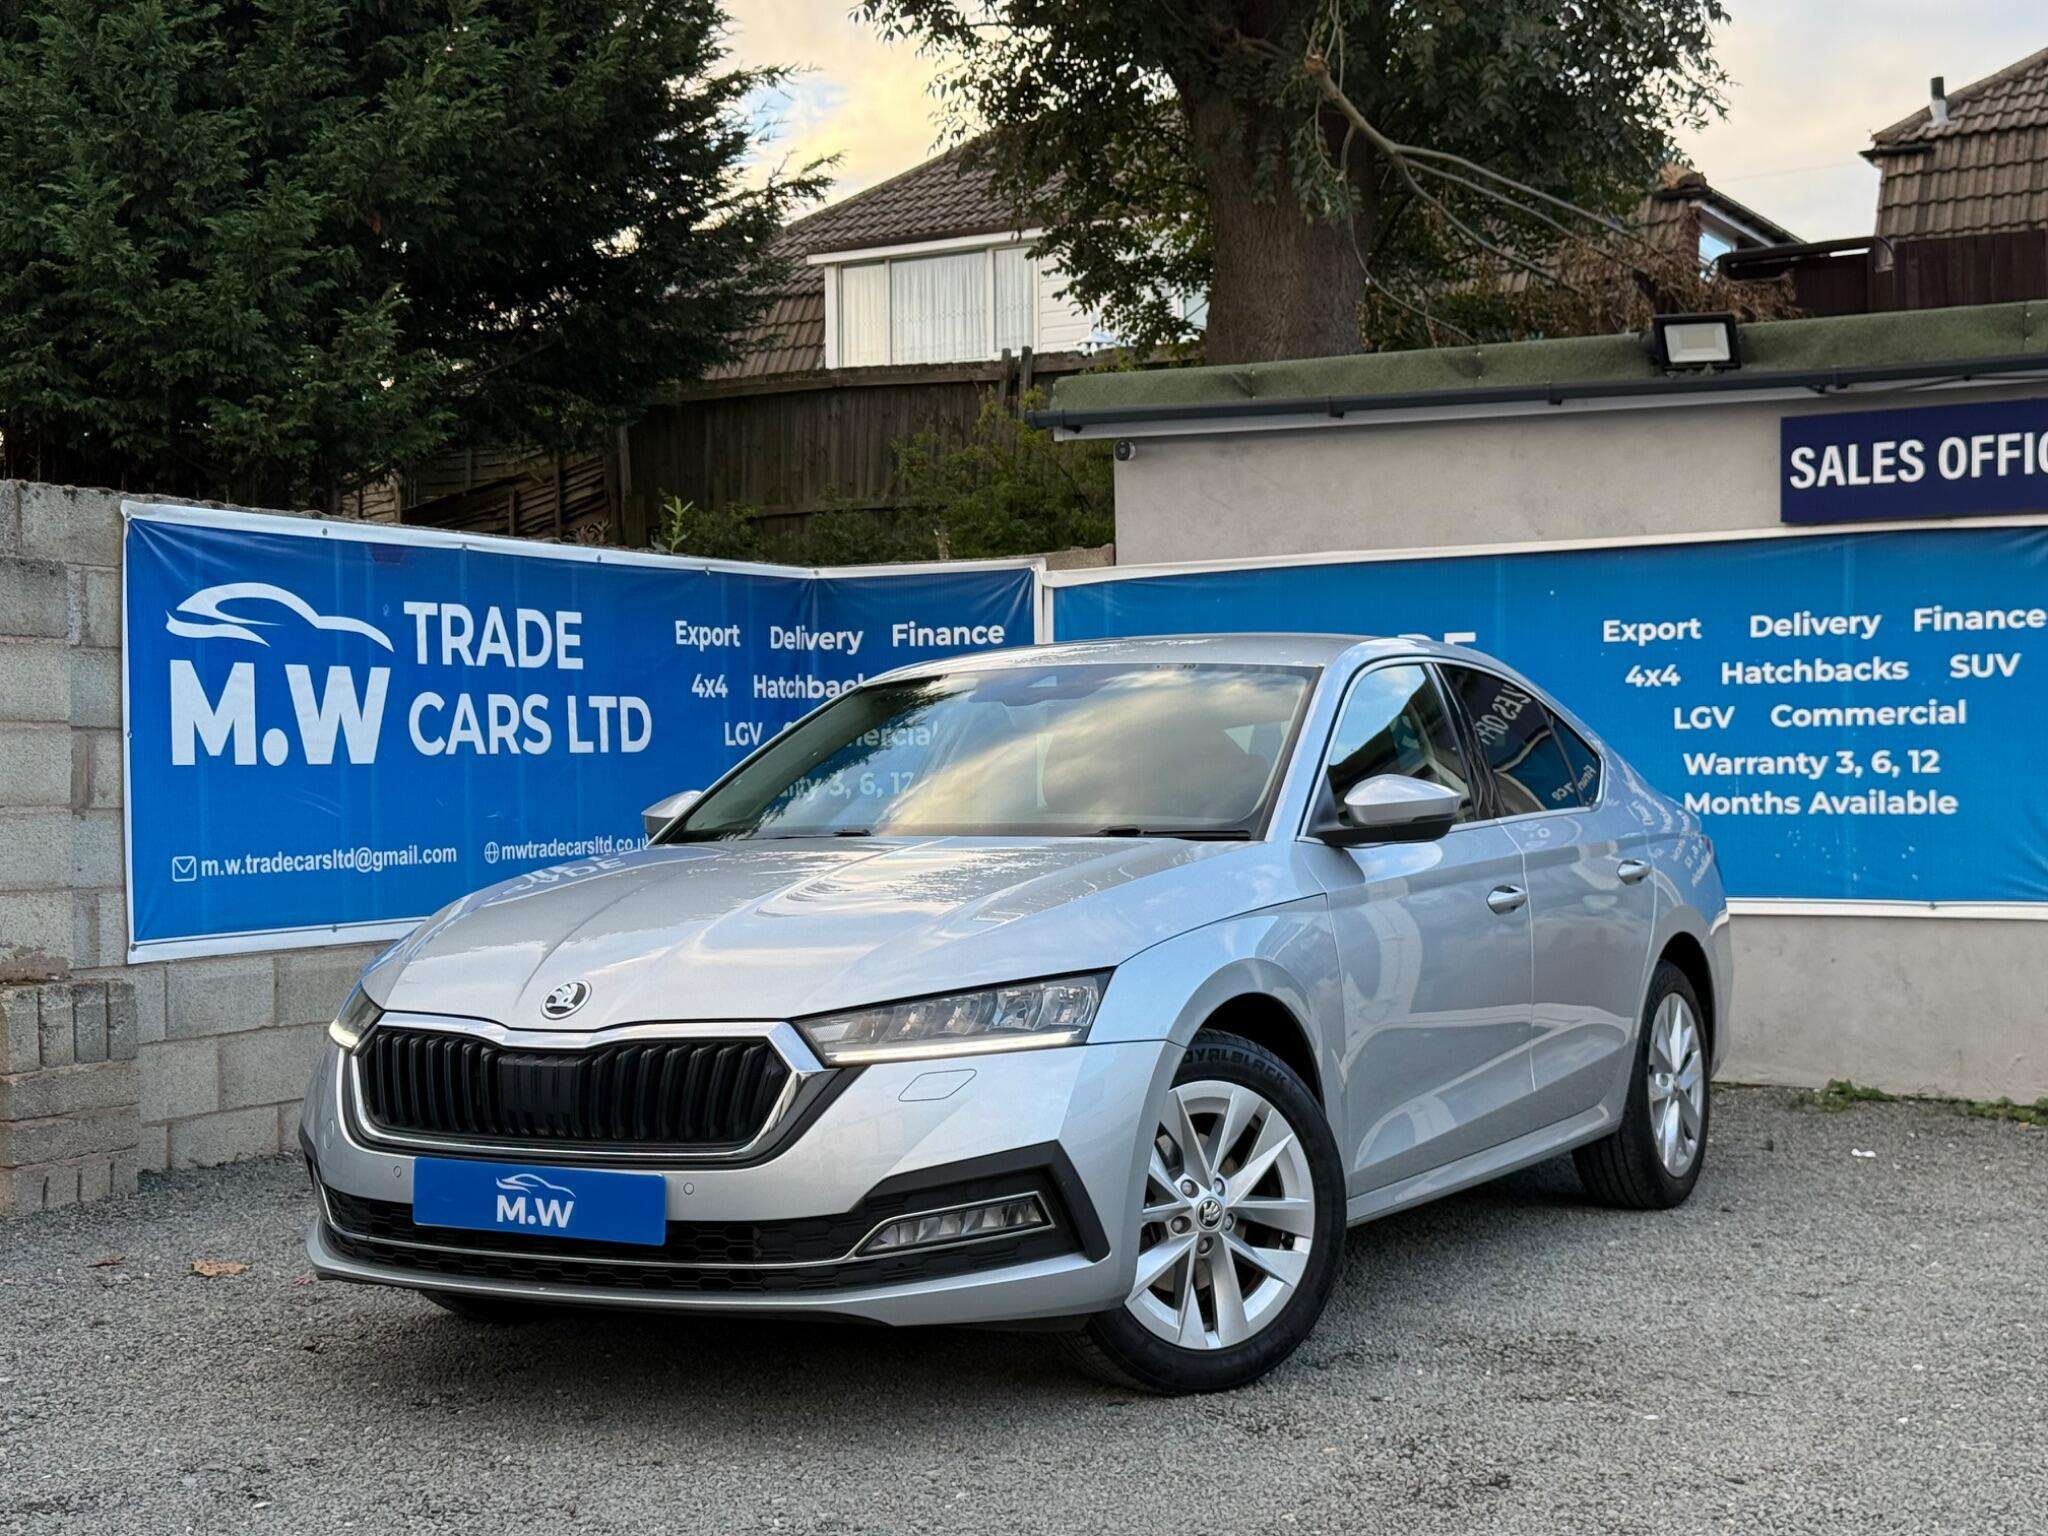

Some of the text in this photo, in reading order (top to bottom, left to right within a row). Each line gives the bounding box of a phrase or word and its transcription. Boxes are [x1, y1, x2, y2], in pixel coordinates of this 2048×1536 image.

[1789, 439, 1925, 489] SALES
[403, 601, 584, 670] TRADE
[675, 620, 1005, 656] Export Delivery Finance
[1603, 605, 2047, 647] Export Delivery Finance
[691, 673, 729, 698] 4x4
[1625, 652, 2021, 687] 4x4 Hatchbacks SUV
[169, 659, 391, 767] M.W
[408, 691, 652, 756] CARS LTD
[1674, 698, 1966, 730] LGV Commercial
[724, 721, 763, 747] LGV
[1683, 749, 1941, 780] Warranty 3, 6, 12
[1683, 788, 1959, 815] Months Available
[201, 844, 457, 877] m.w.tradecarsltd@gmail.com
[496, 1191, 576, 1228] M.W
